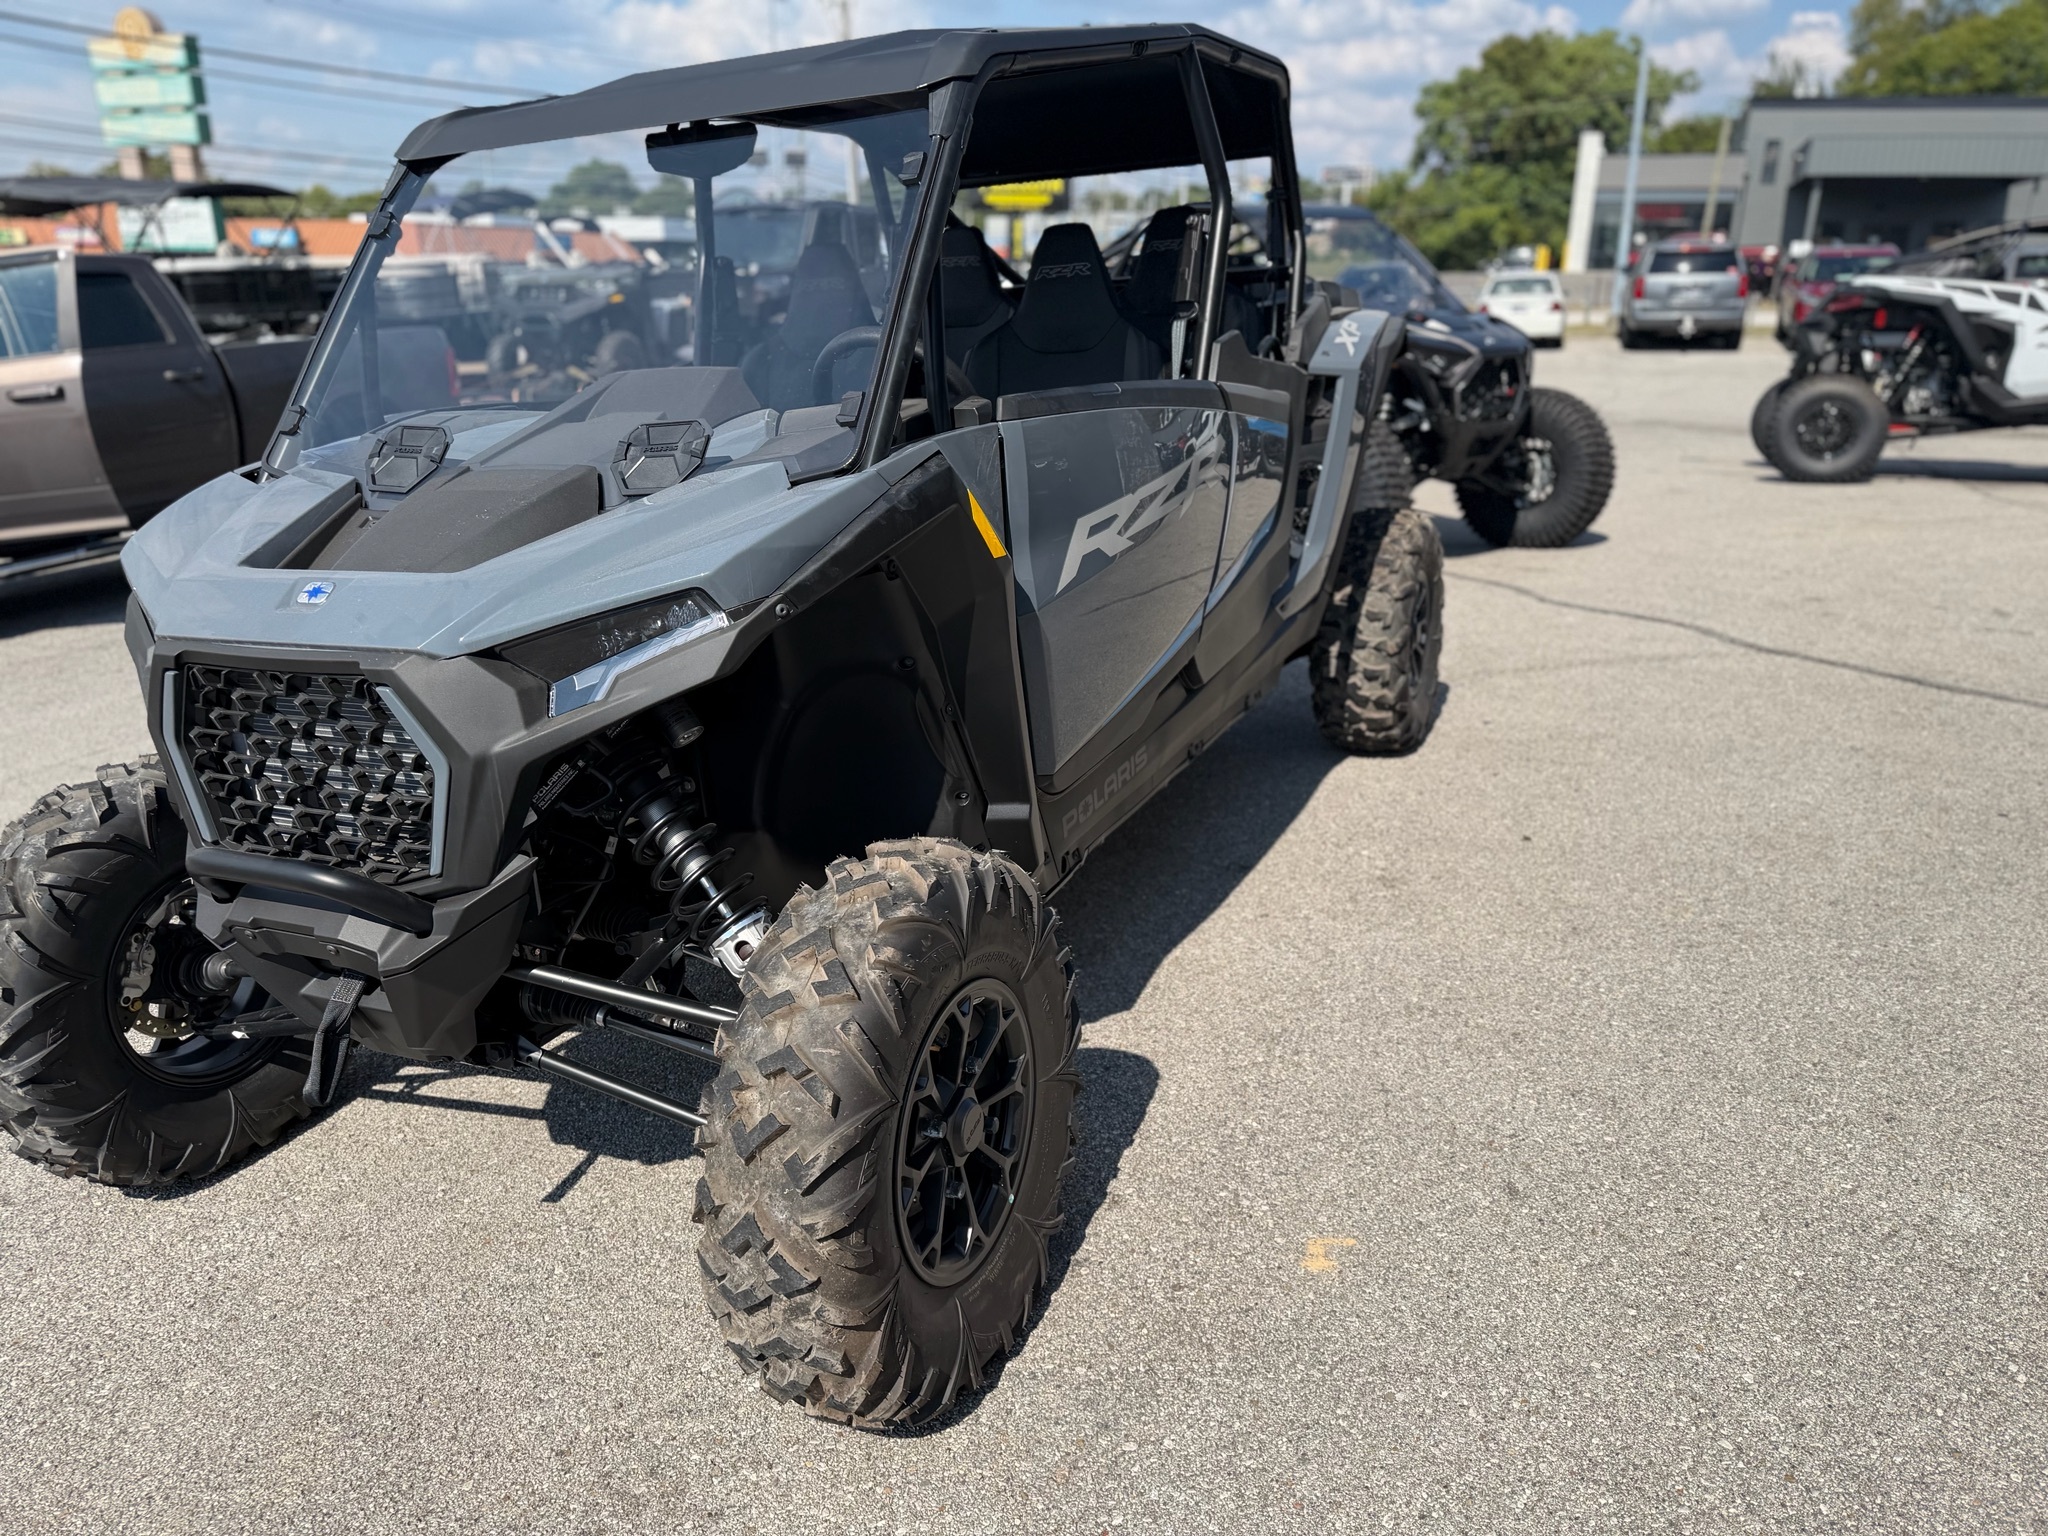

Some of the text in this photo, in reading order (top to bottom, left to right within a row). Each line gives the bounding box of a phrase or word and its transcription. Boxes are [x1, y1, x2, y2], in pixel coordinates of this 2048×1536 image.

[1034, 262, 1092, 281] RZR
[1334, 319, 1361, 357] XP
[1055, 433, 1227, 597] RZR
[532, 763, 569, 803] POLARIS
[1062, 745, 1148, 839] POLARIS
